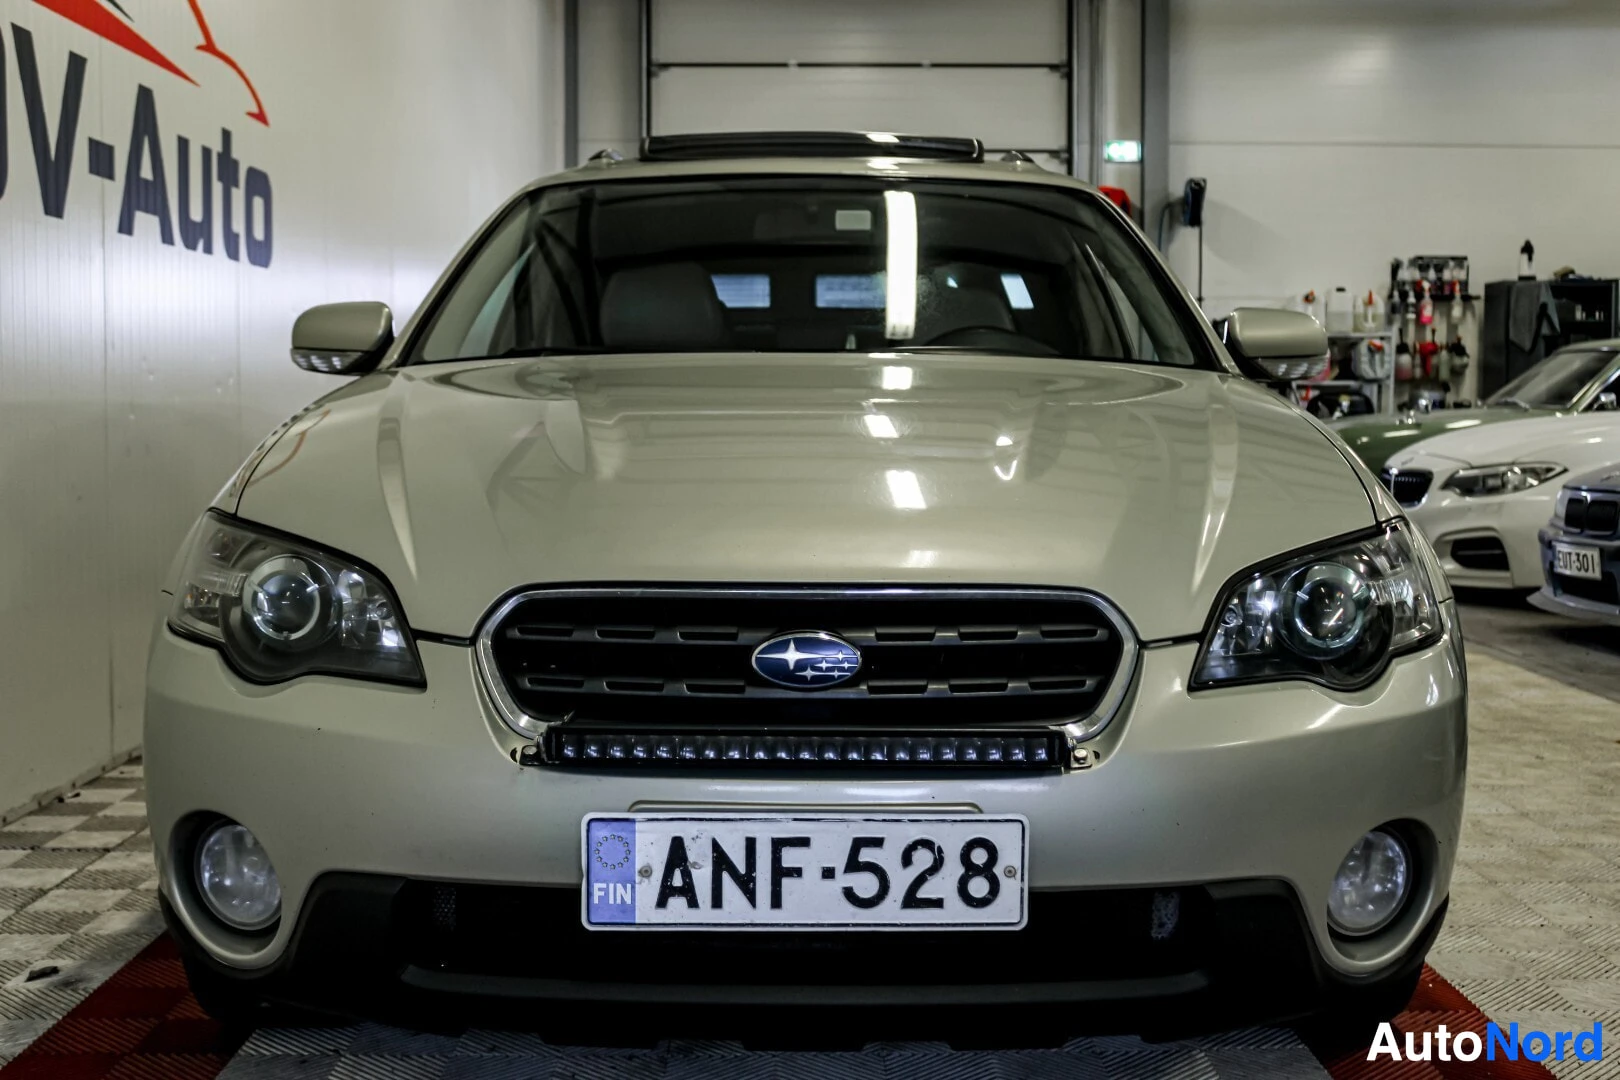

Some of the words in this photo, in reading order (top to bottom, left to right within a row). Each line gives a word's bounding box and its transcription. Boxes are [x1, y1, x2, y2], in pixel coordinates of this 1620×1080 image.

[0, 22, 273, 269] V-Auto
[593, 882, 632, 905] FIN
[655, 836, 999, 909] ANF-528
